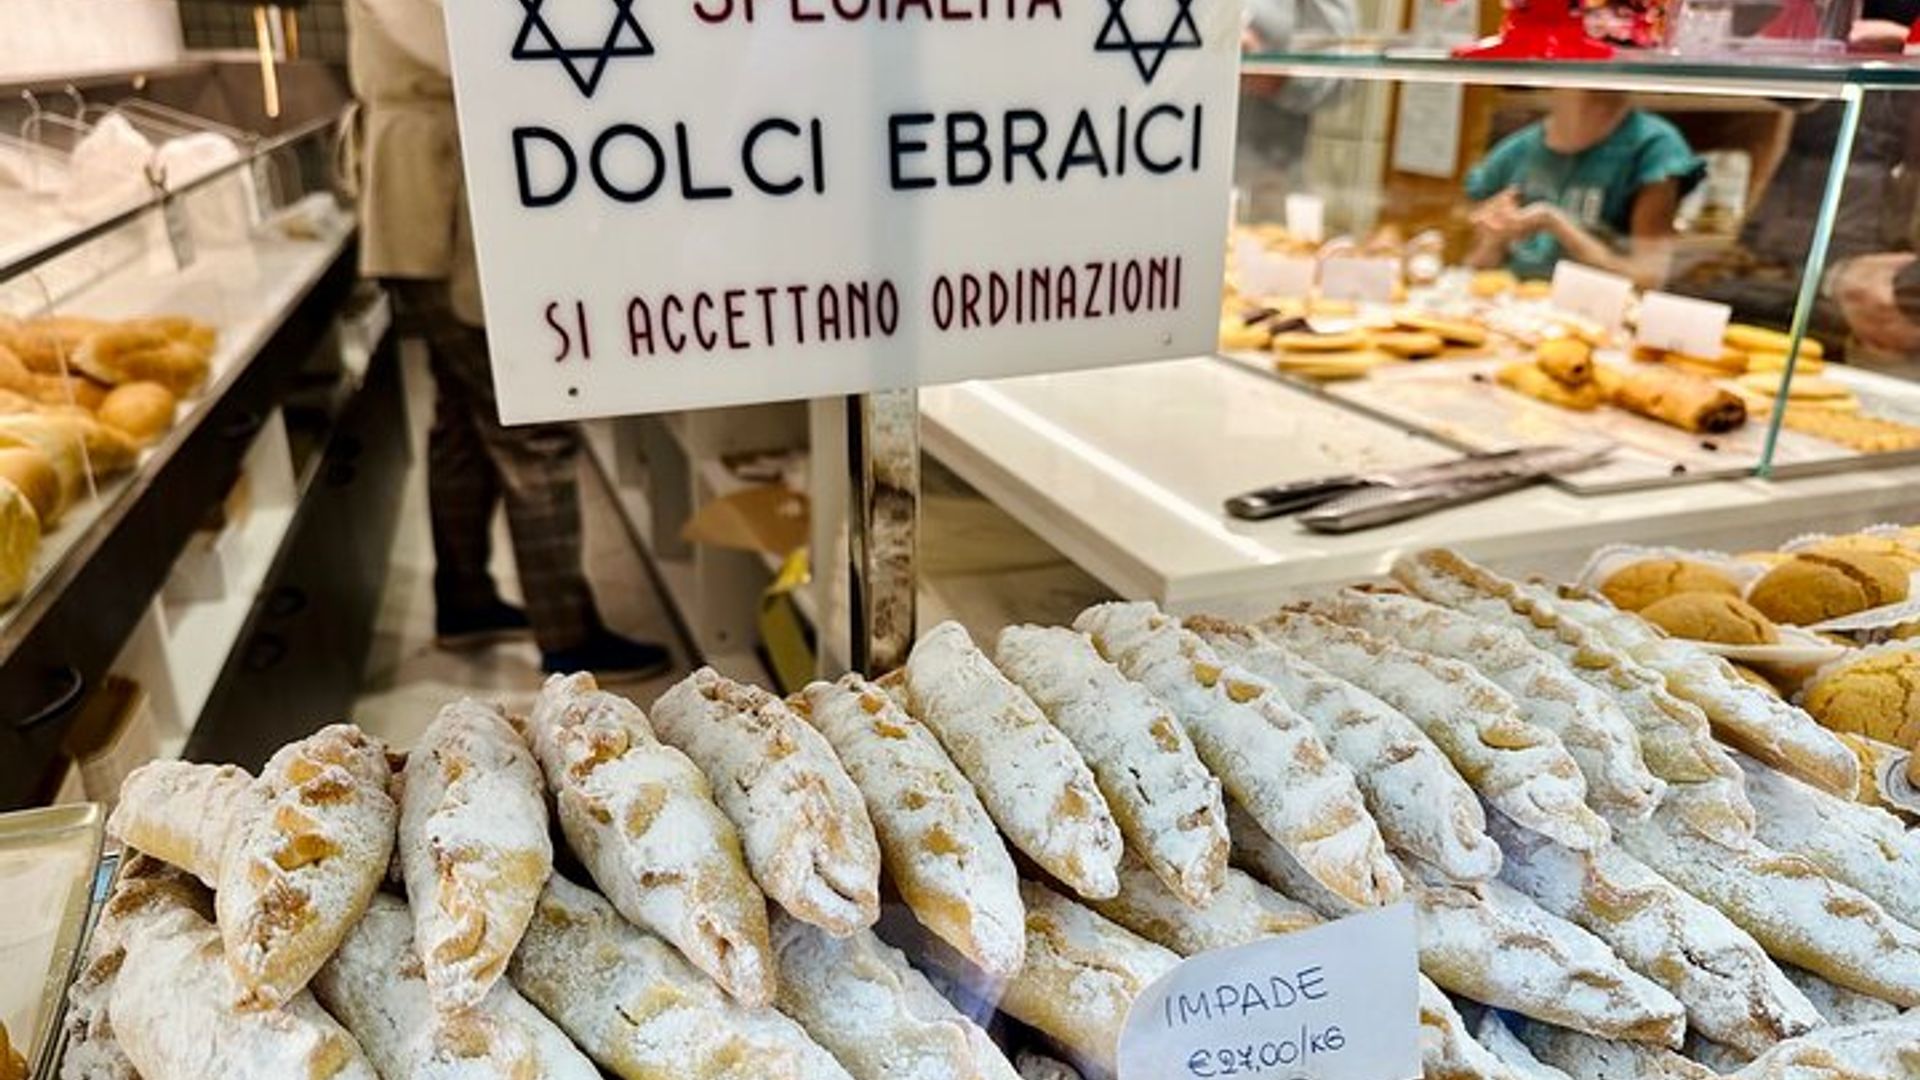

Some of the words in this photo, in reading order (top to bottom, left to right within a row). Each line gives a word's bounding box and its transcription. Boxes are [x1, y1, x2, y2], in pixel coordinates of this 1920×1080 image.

[511, 117, 825, 208] DOLCI
[887, 103, 1203, 191] EBRAICI
[545, 300, 590, 363] SI
[627, 278, 900, 356] ACCETTANO
[932, 255, 1182, 332] ORDINAZIONI
[1165, 966, 1329, 1027] IMPADE
